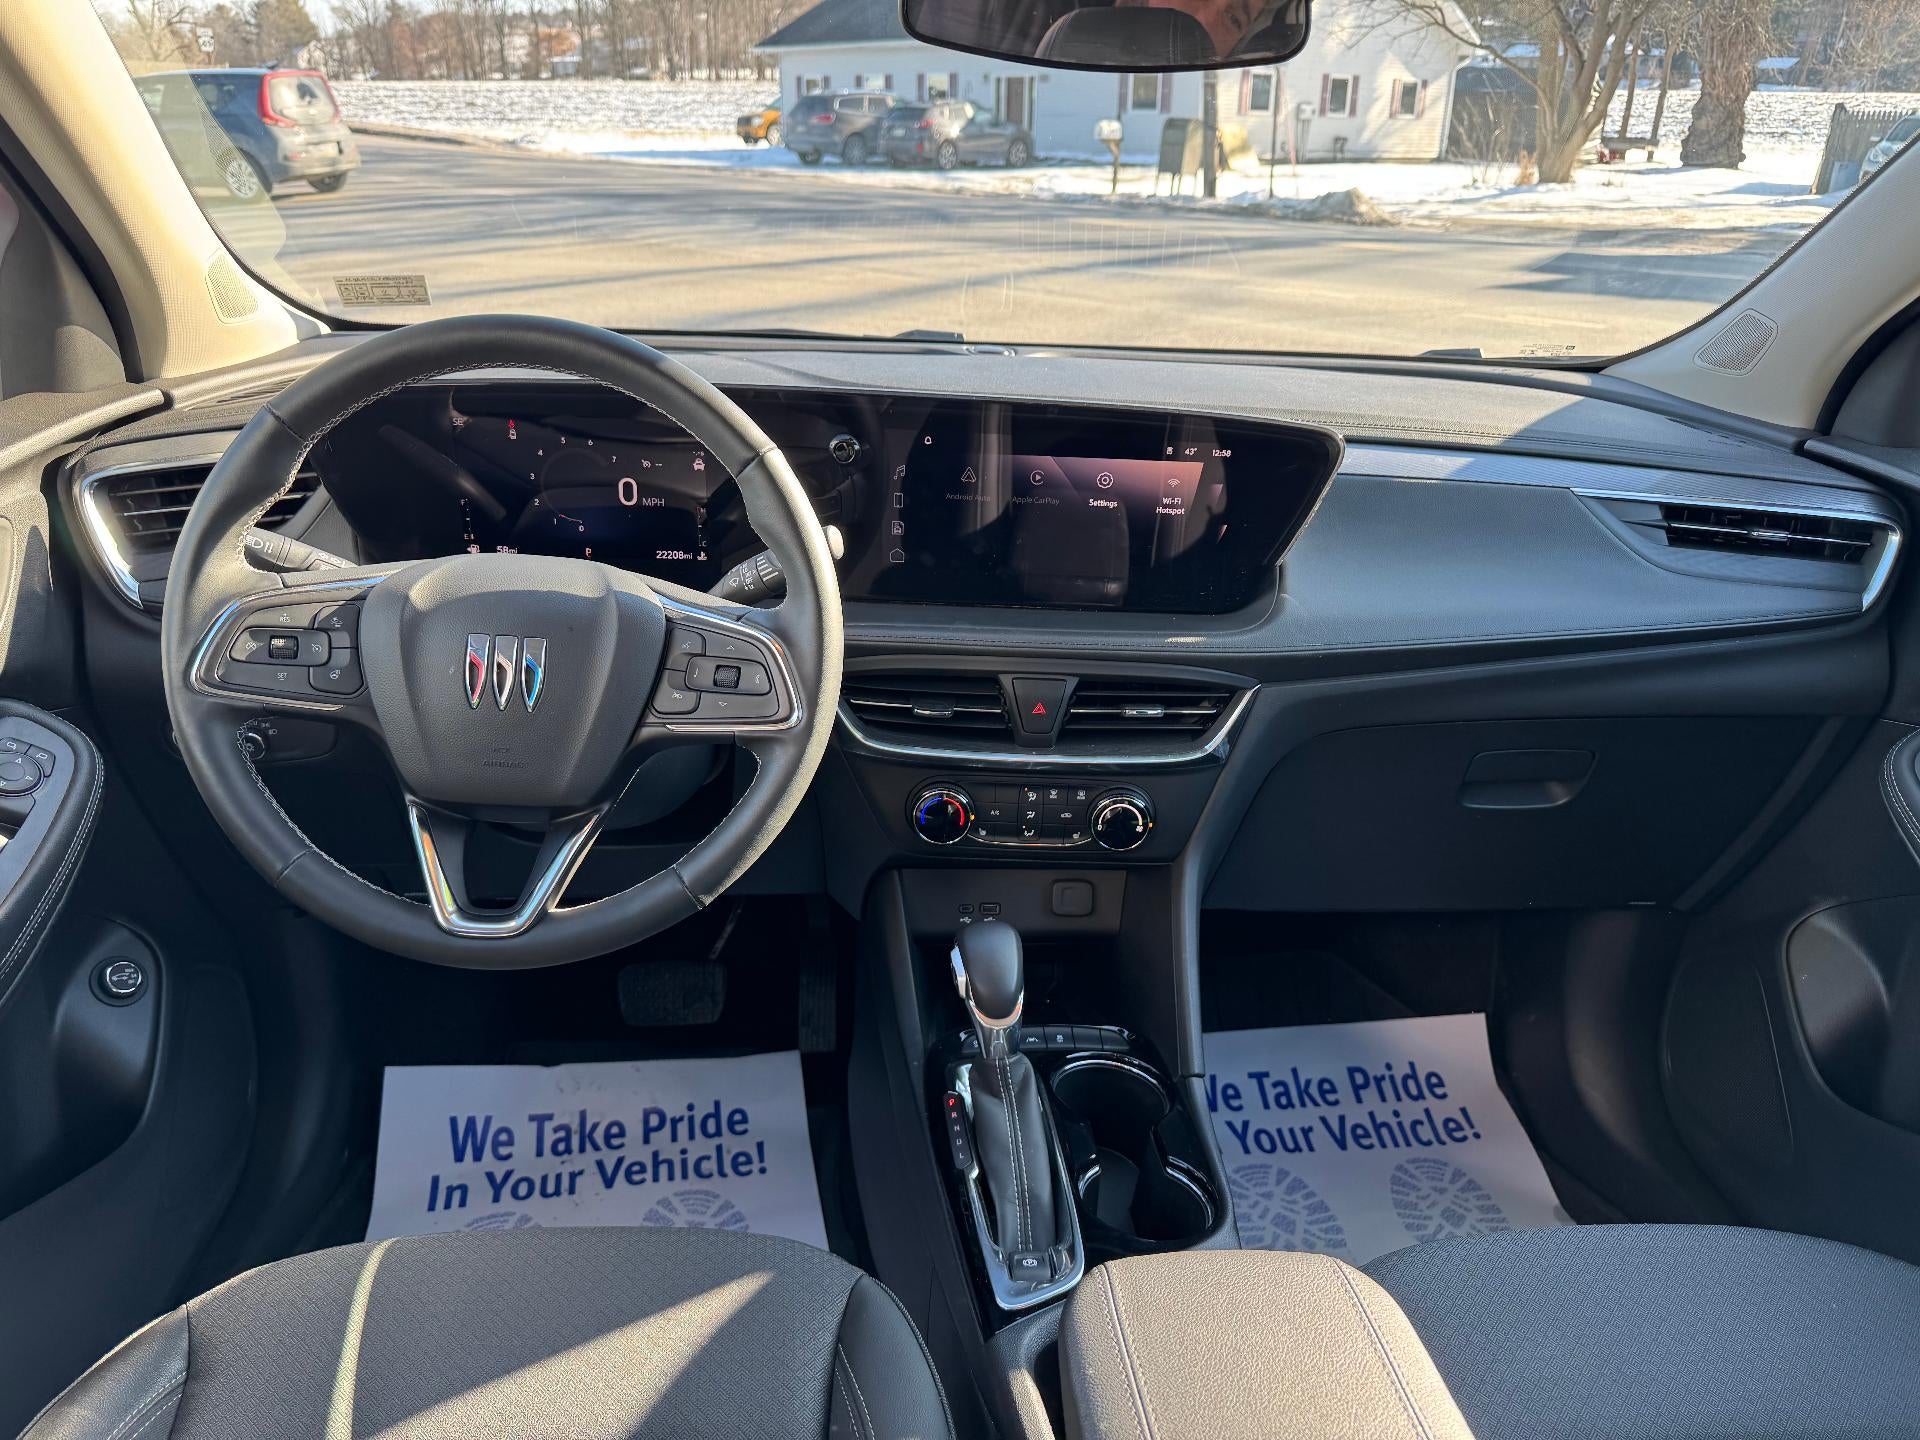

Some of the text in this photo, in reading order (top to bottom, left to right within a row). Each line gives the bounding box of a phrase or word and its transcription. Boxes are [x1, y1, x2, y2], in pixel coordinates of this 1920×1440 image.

[1212, 449, 1232, 458] 12:58
[530, 472, 535, 480] 3
[618, 477, 638, 506] 0
[945, 492, 973, 501] Android
[534, 498, 539, 506] 2
[642, 497, 665, 507] MPH
[1011, 496, 1060, 506] Apple CarPlay
[1089, 498, 1118, 509] Settings
[1156, 506, 1185, 516] Hotspot
[1247, 1066, 1341, 1111] Take
[1346, 1060, 1449, 1104] Pride
[949, 1098, 955, 1106] P
[449, 1099, 750, 1164] We Take Pride
[1225, 1106, 1482, 1155] Your Vehicle!
[426, 1140, 768, 1213] In Your Vehicle!
